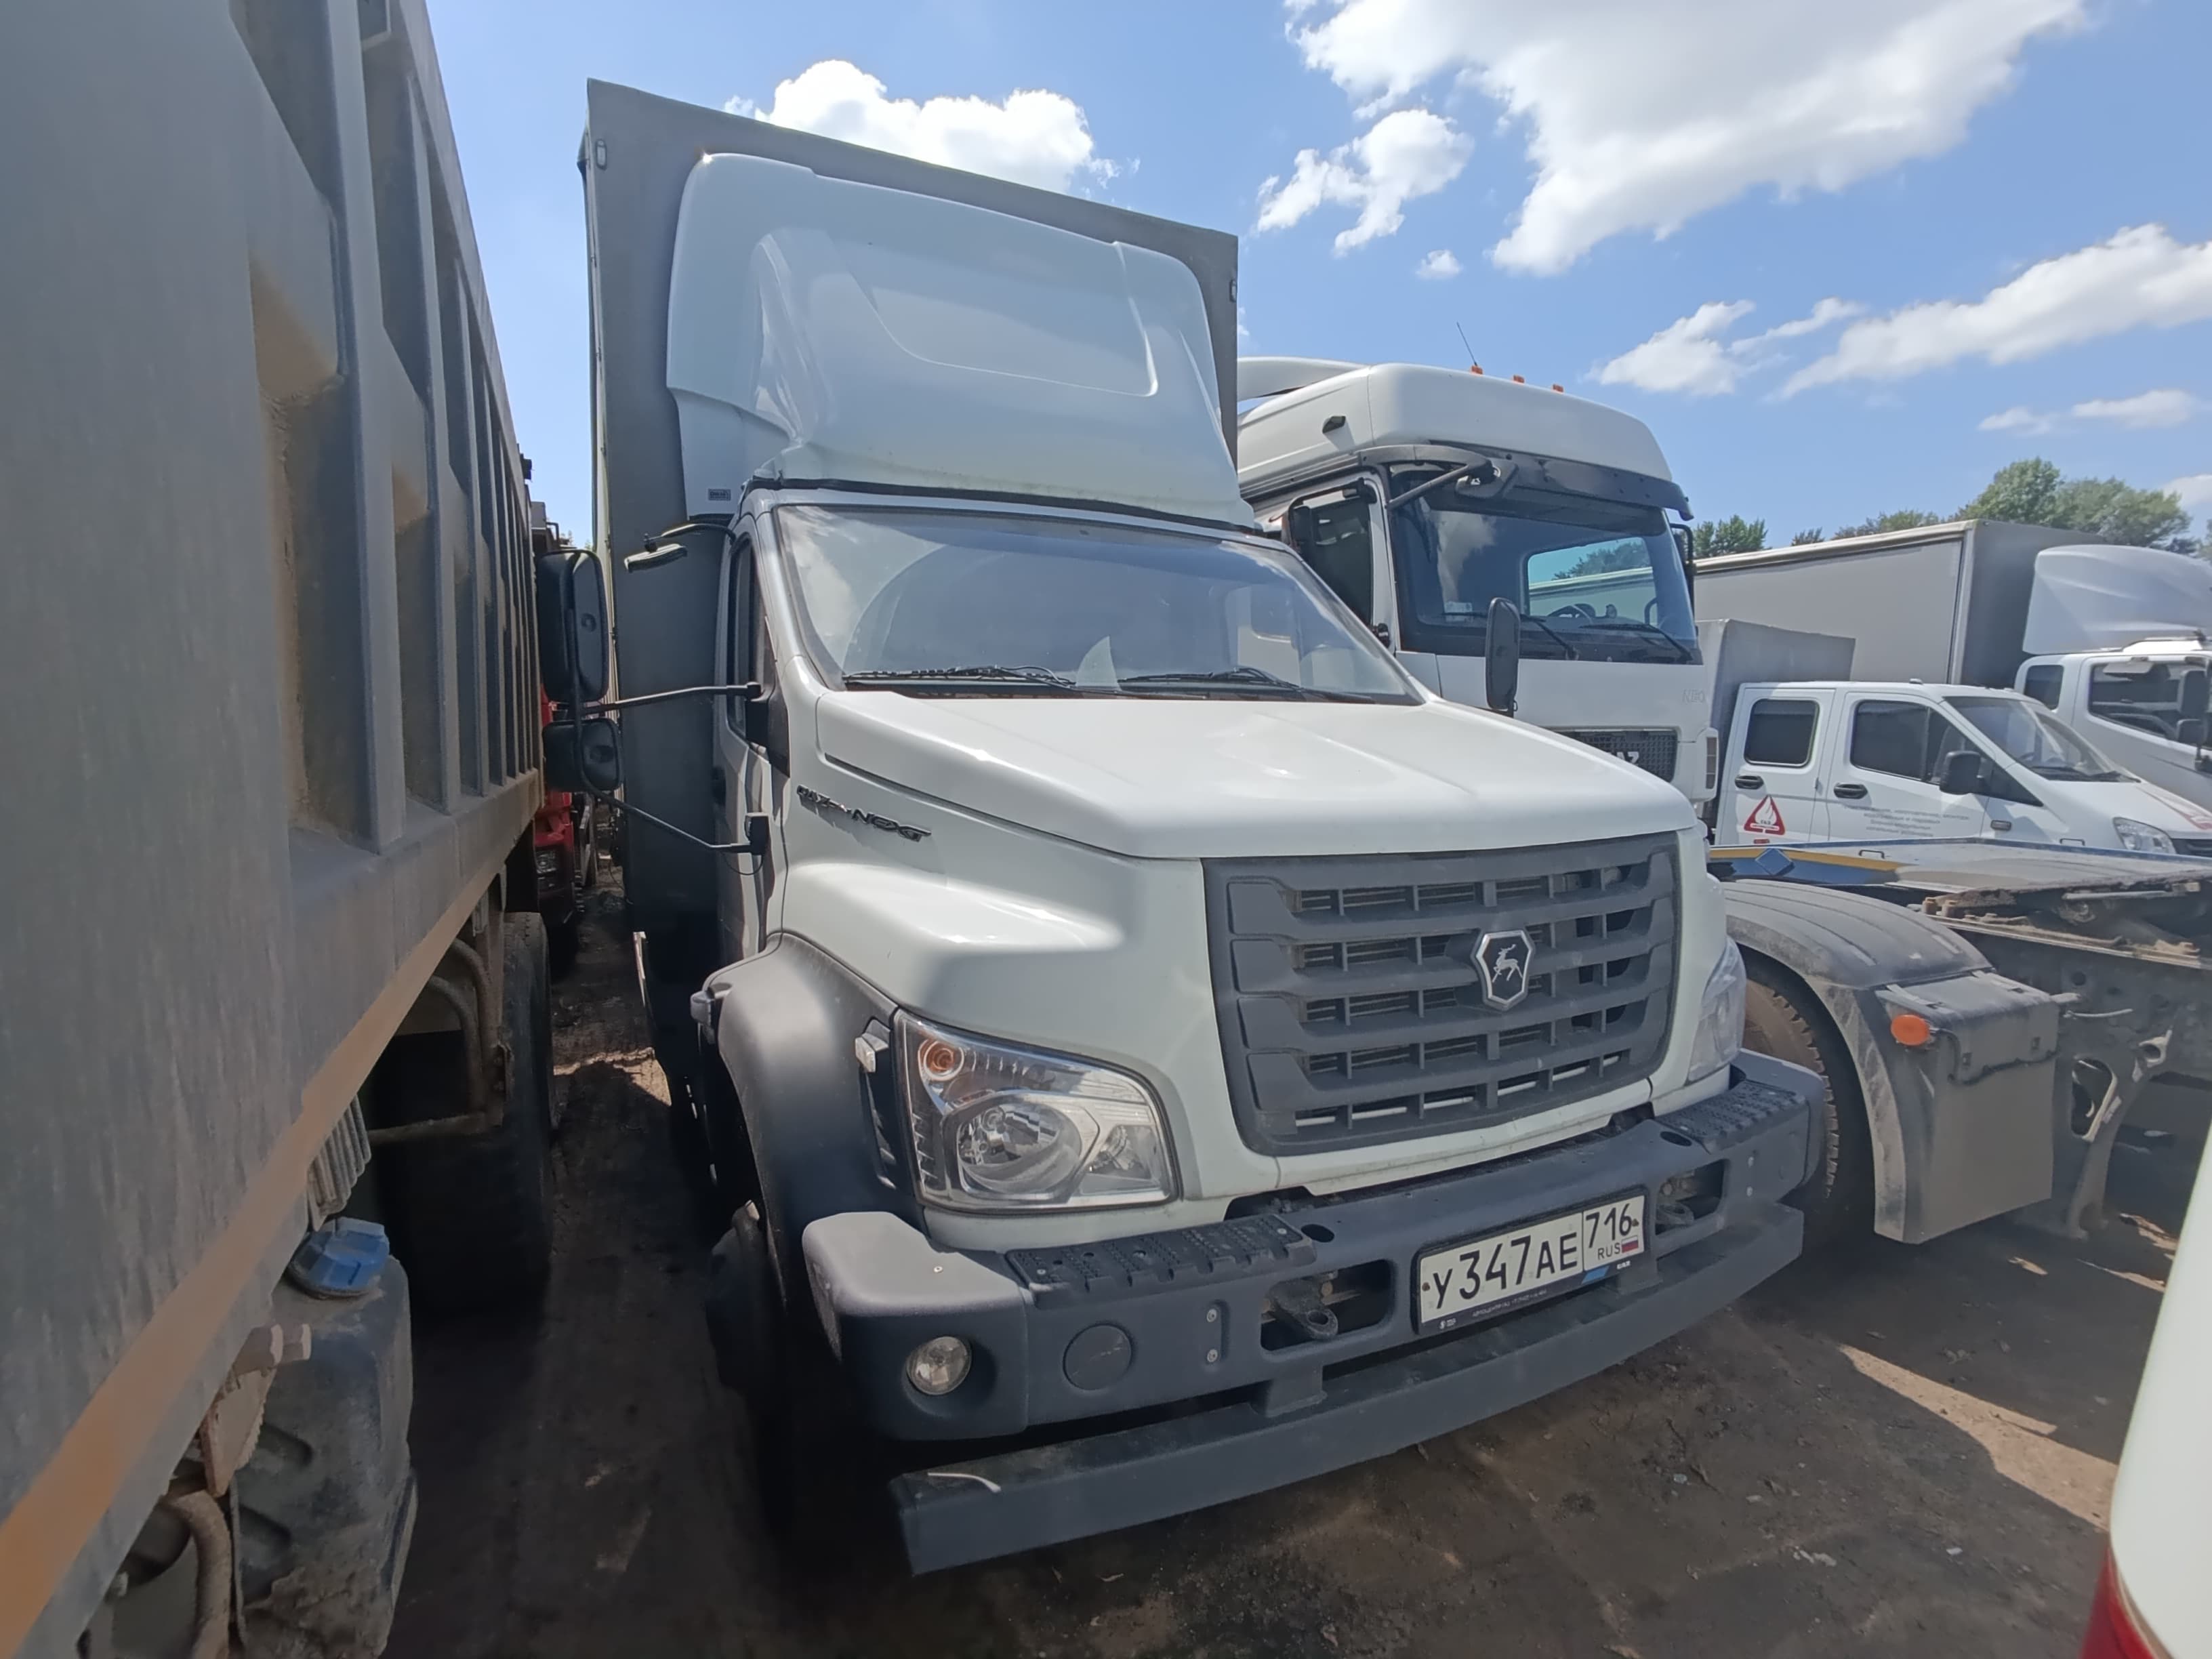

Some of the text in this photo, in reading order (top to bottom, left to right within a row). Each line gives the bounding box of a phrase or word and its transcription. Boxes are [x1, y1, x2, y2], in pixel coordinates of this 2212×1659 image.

[797, 784, 851, 813] GAZ
[1586, 1203, 1633, 1248] 716
[1597, 1242, 1620, 1260] RUS
[1433, 1232, 1578, 1309] У347АЕ
